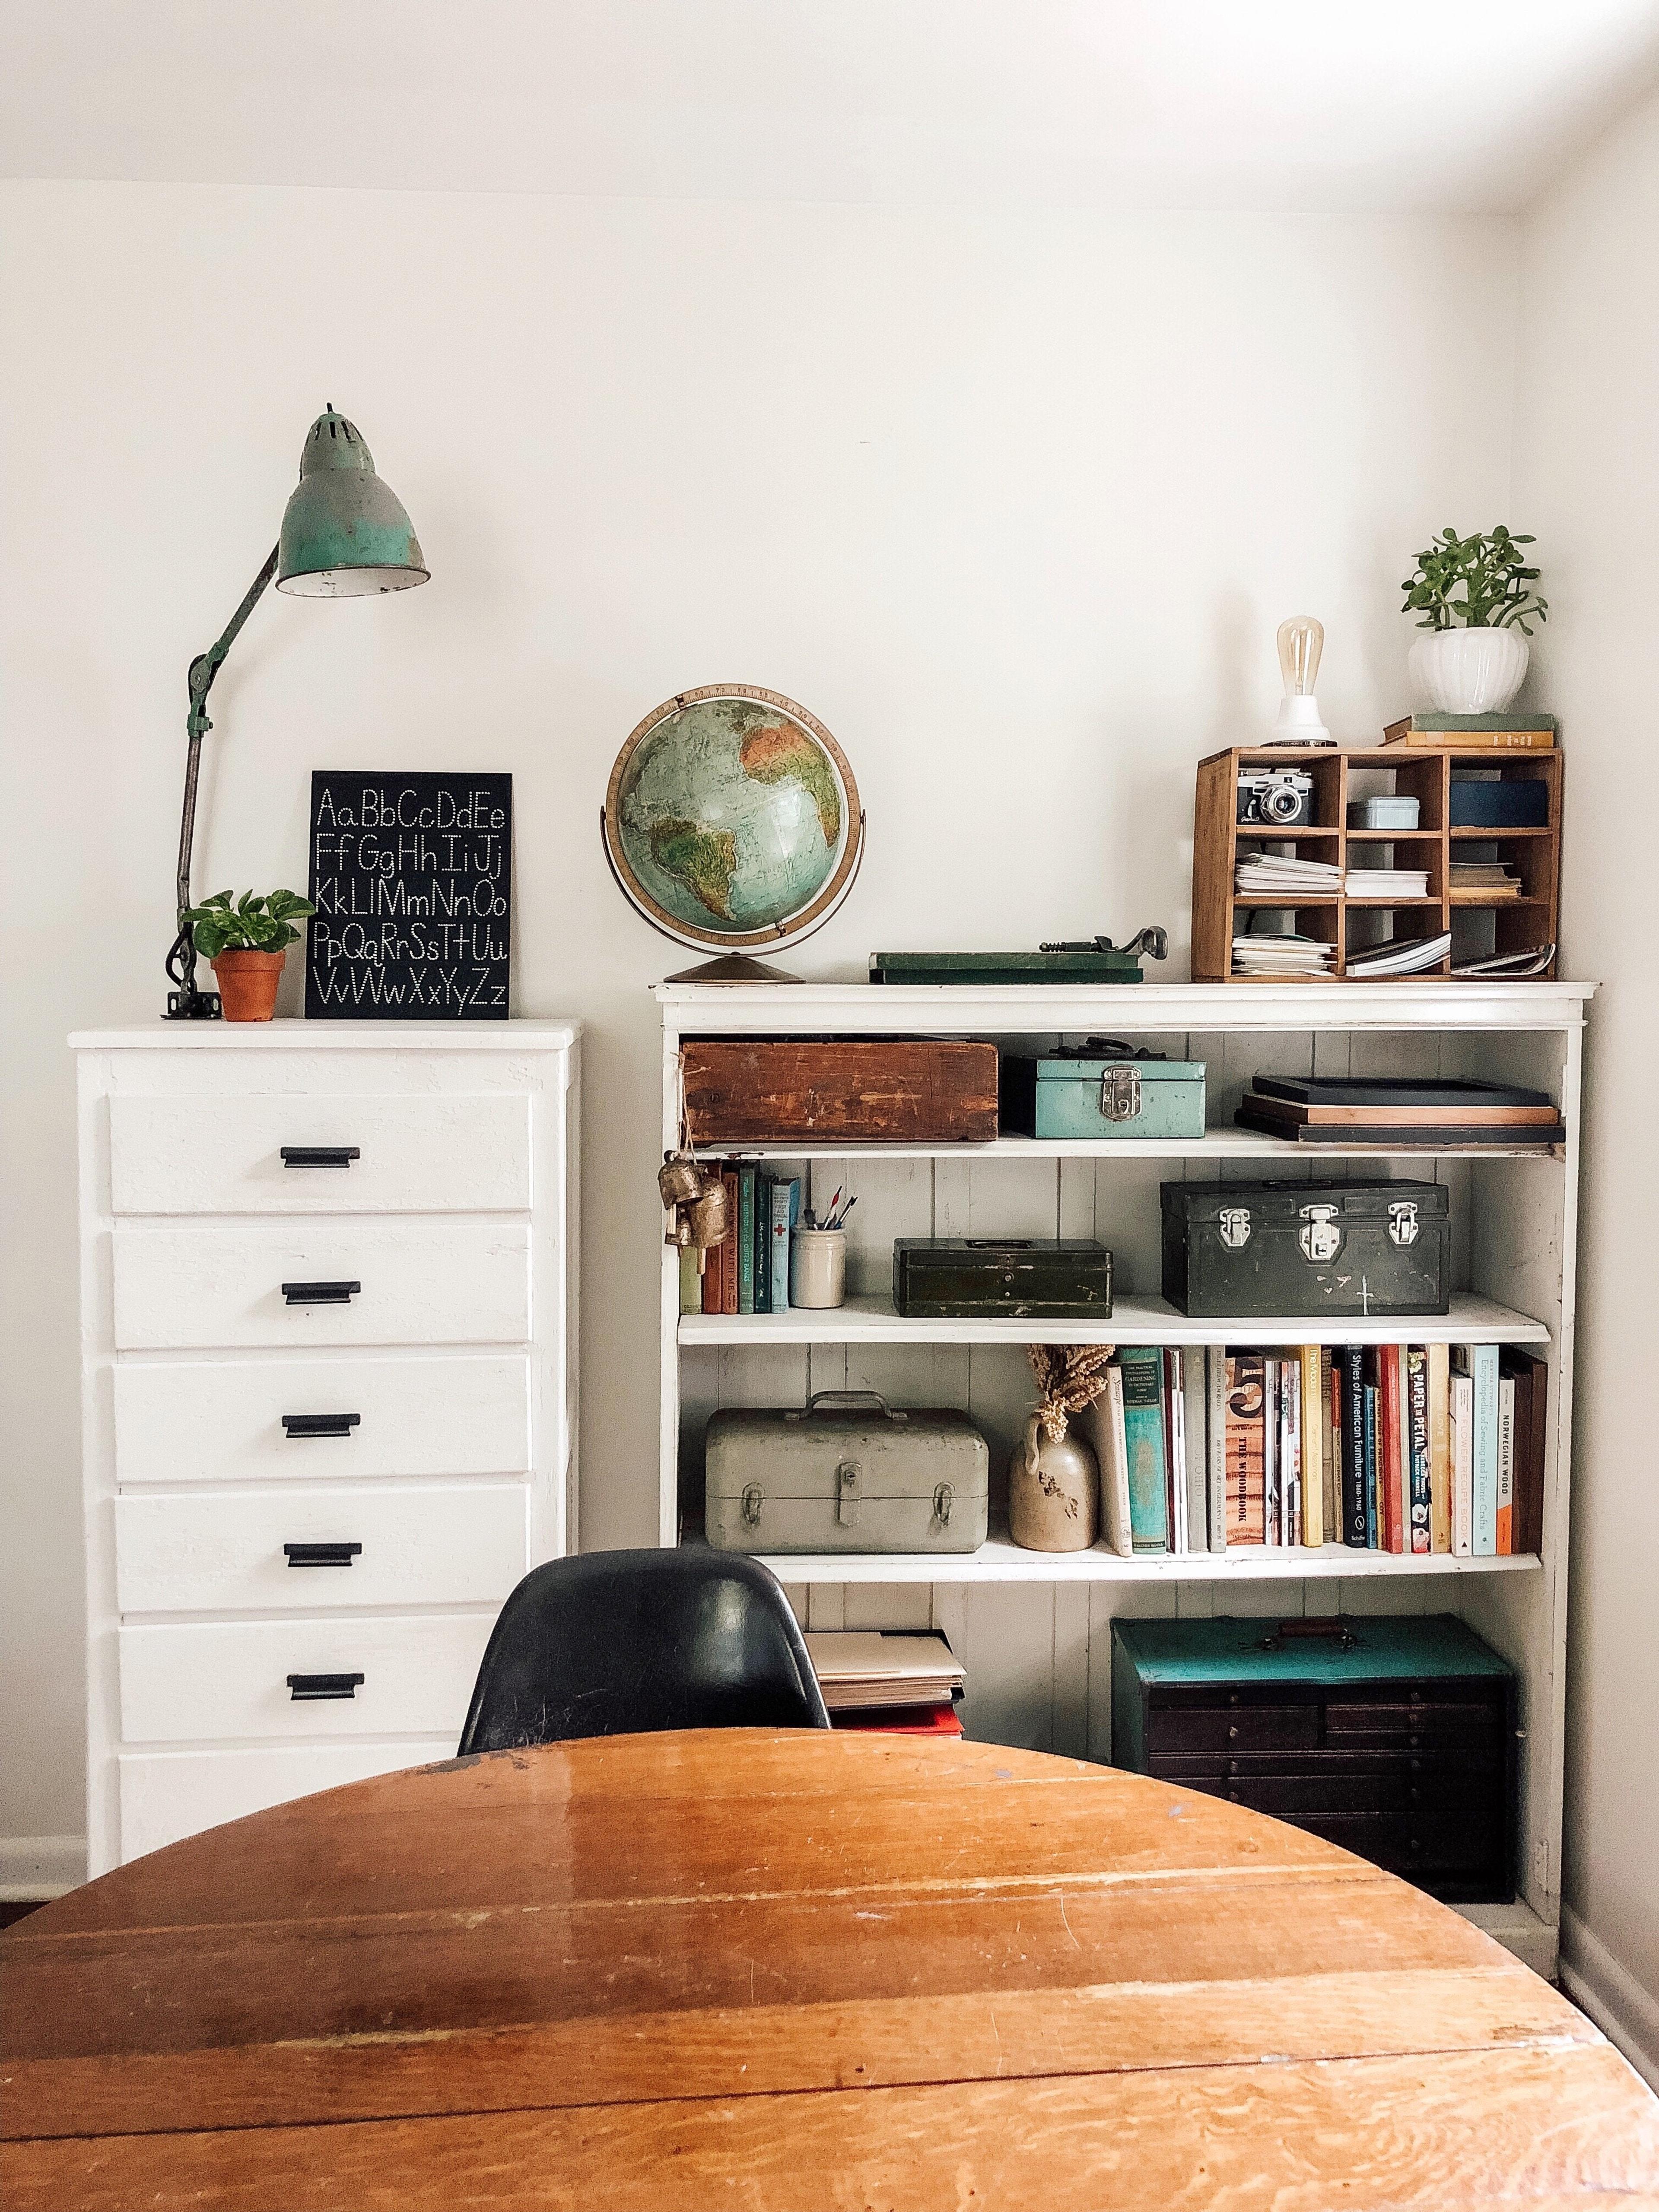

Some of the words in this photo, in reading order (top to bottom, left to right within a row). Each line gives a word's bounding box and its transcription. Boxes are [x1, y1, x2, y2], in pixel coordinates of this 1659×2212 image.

[728, 1278, 735, 1290] ME
[1351, 1355, 1362, 1380] Styles
[1353, 1382, 1362, 1391] of
[1413, 1374, 1425, 1408] PAPER
[1479, 1359, 1488, 1414] Encyclopedia
[1353, 1393, 1363, 1438] American
[1480, 1416, 1489, 1424] of
[1414, 1417, 1425, 1449] PETAL
[1478, 1426, 1488, 1456] Sewing
[1239, 1437, 1247, 1459] THE
[1355, 1440, 1363, 1478] Furniture
[1479, 1459, 1488, 1473] and
[1195, 1466, 1203, 1496] OHIO
[1238, 1462, 1247, 1522] WOODBOOK
[1479, 1476, 1488, 1501] Fabric
[1479, 1504, 1488, 1530] Crafts
